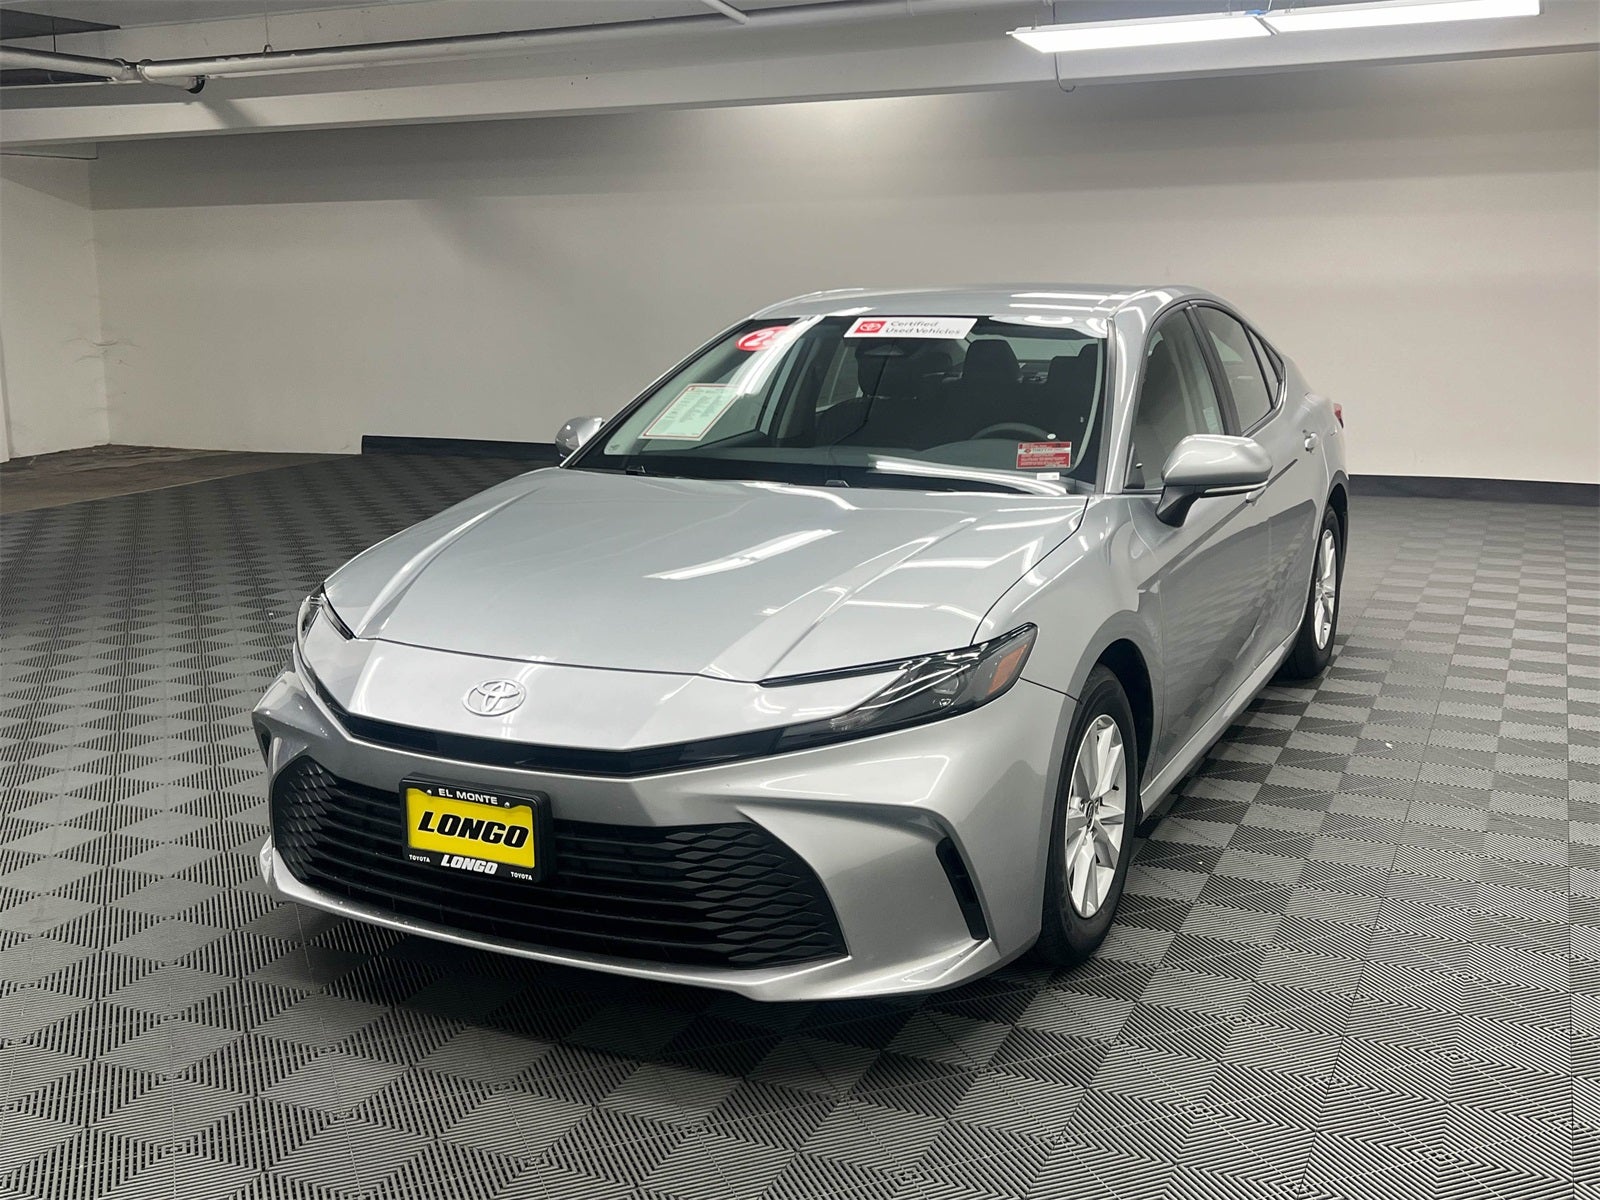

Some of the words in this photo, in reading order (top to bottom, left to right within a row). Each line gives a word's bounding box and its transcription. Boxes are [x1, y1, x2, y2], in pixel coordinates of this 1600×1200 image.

[890, 320, 939, 328] Certified
[916, 327, 961, 335] Vehicles
[438, 788, 453, 798] EL
[456, 791, 499, 805] MONTE
[417, 810, 530, 849] LONGO
[409, 854, 431, 863] TOYOTA
[441, 854, 499, 876] LONGO
[510, 871, 533, 881] TOYOTA
